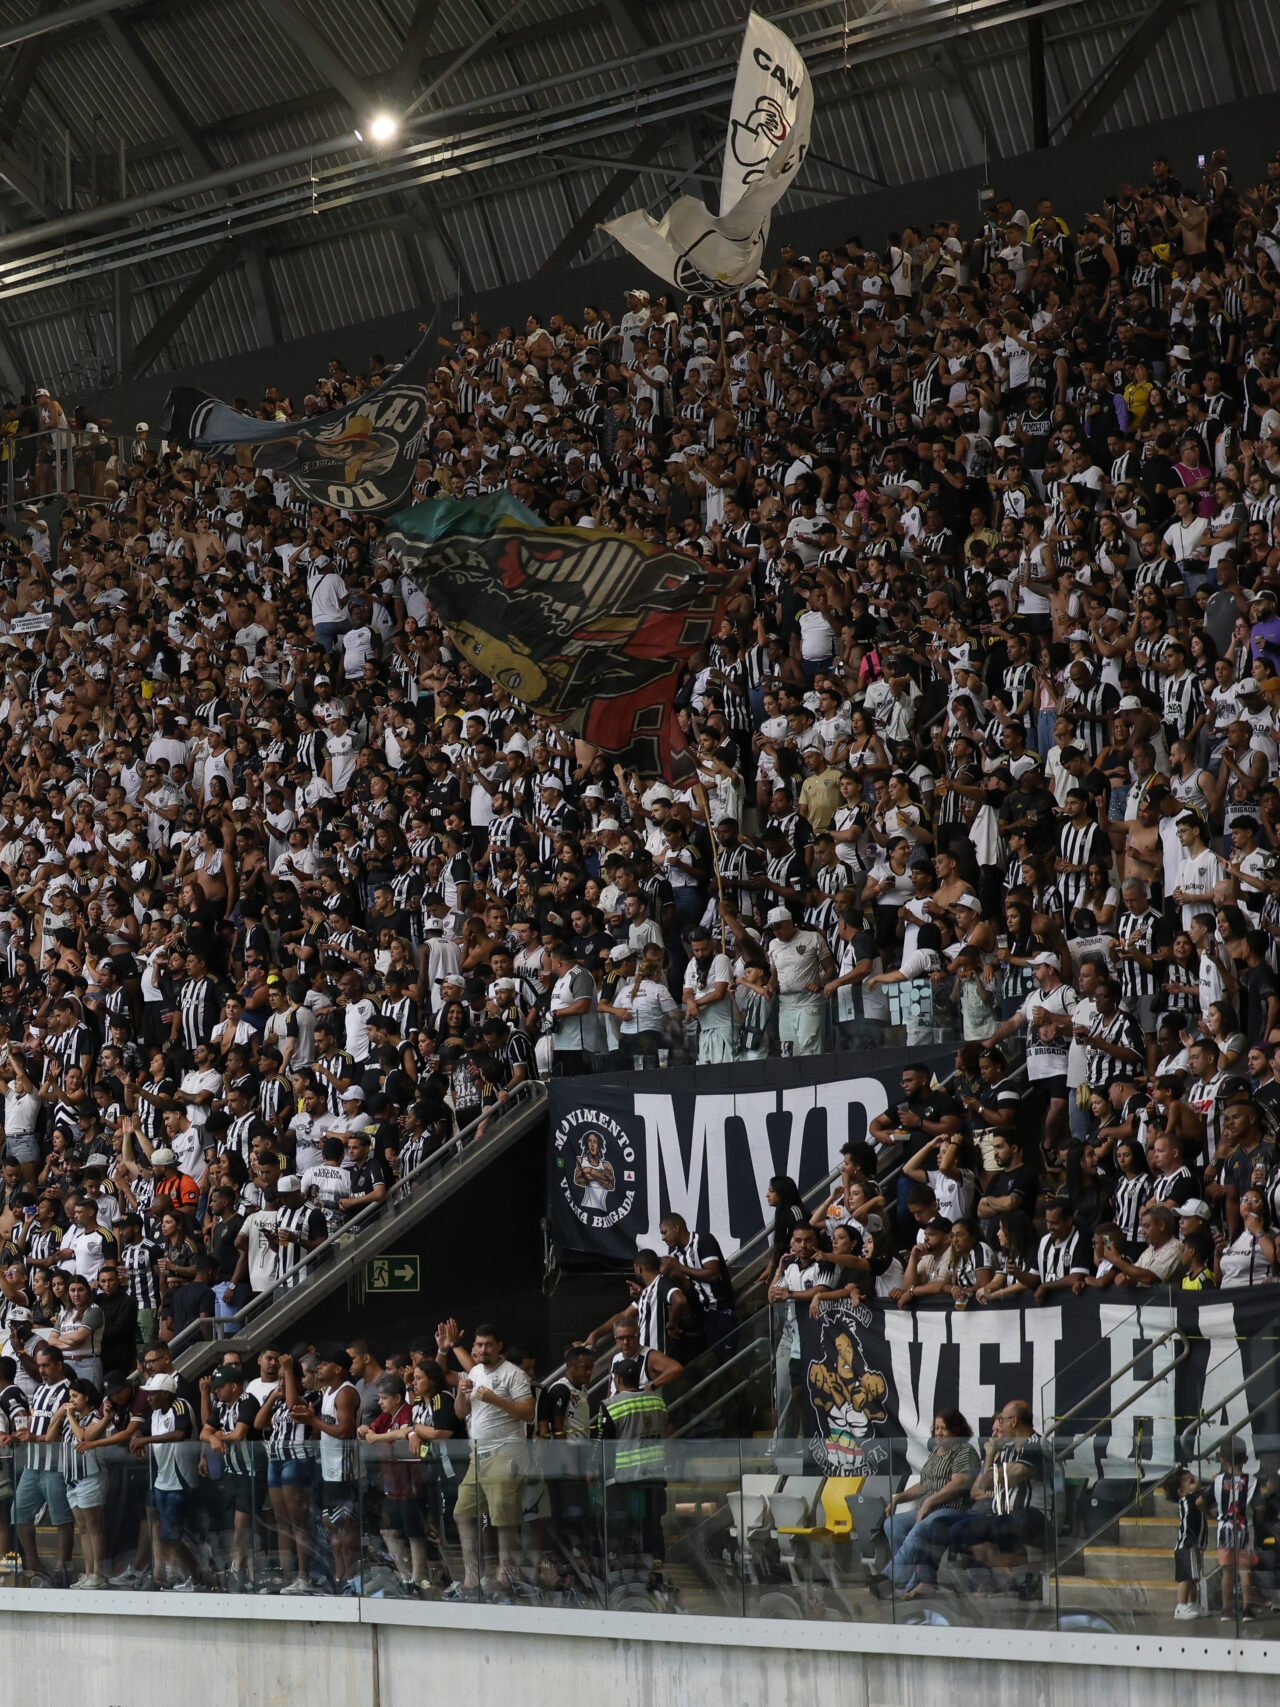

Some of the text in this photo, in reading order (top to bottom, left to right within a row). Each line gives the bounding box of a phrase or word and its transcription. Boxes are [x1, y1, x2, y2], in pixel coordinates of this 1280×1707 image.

[1230, 806, 1257, 814] BRIGADA
[490, 834, 508, 842] BETANO
[1034, 1046, 1068, 1057] BRIGADA
[554, 1108, 636, 1163] MOVIMENTO
[314, 1172, 342, 1180] BRIGADA
[560, 1176, 636, 1231] VELHA BRIGADA
[826, 1205, 842, 1218] MG
[258, 1239, 269, 1257] 7
[884, 1302, 1261, 1483] VELHA
[33, 1410, 53, 1418] BETANO
